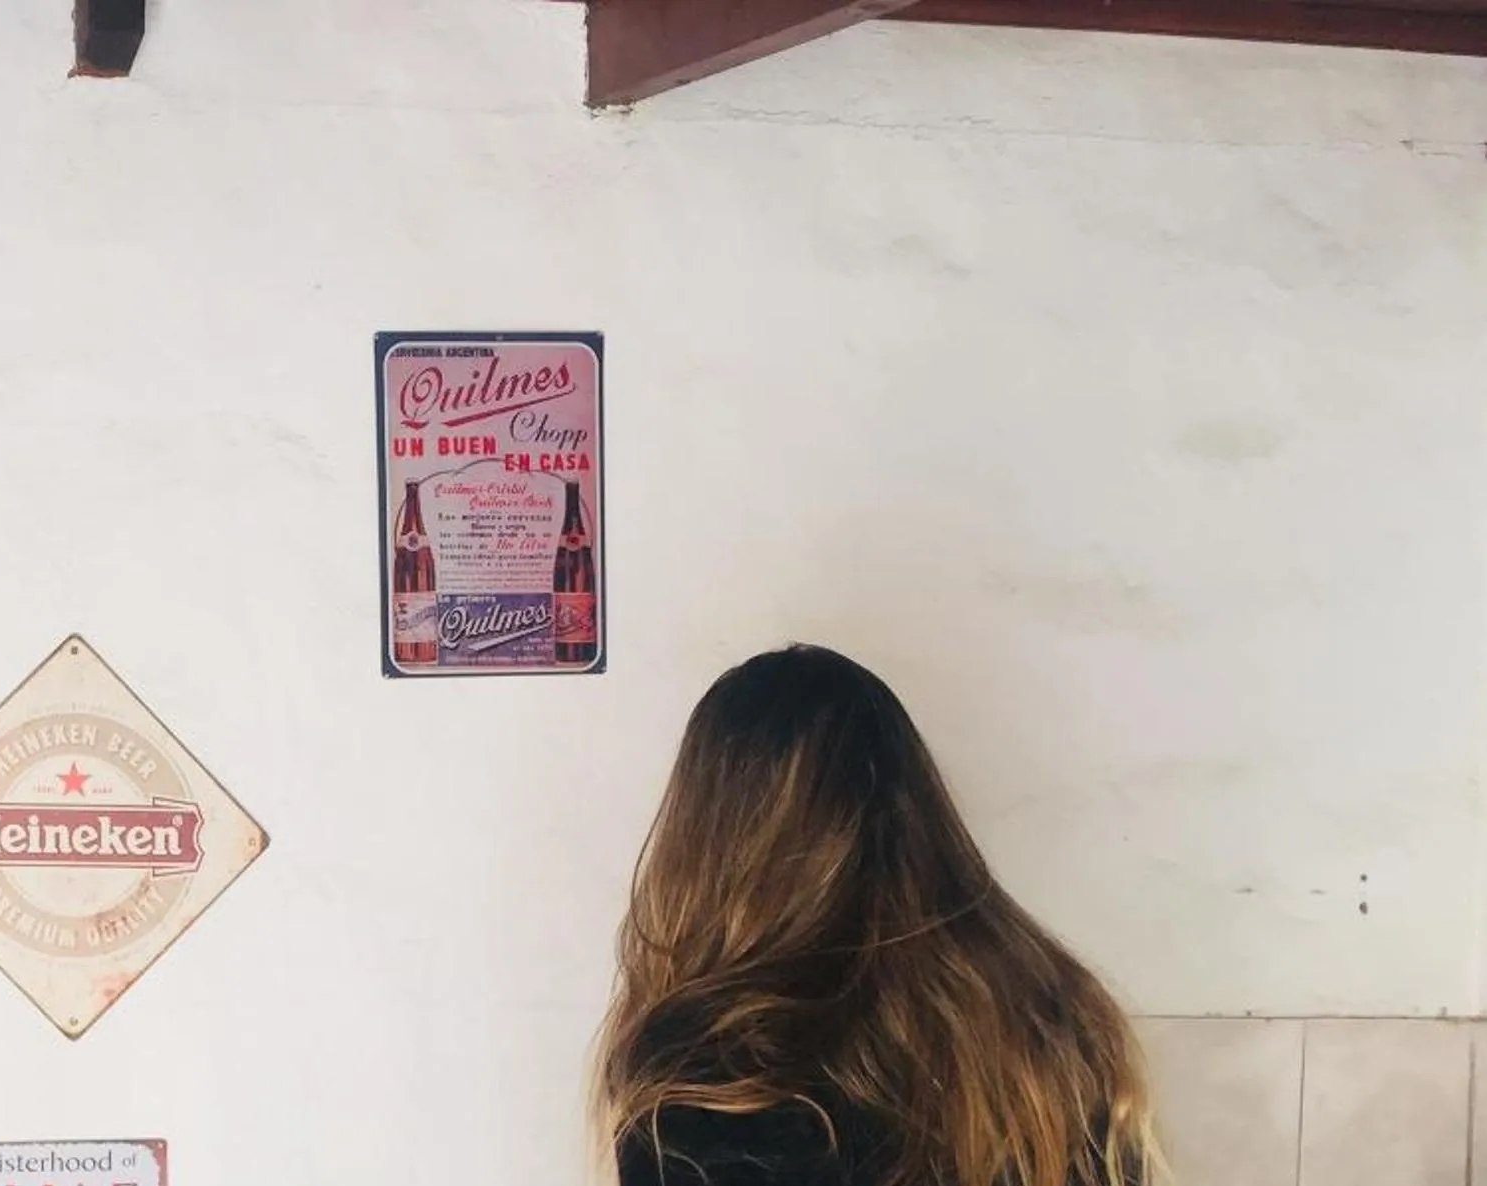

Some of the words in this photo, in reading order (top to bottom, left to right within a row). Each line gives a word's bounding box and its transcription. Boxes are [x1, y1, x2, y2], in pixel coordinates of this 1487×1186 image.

[399, 356, 575, 429] Quilmes
[393, 438, 424, 457] UN
[438, 436, 496, 455] BUEN
[510, 410, 588, 450] Chopp
[505, 453, 530, 472] EN
[540, 453, 591, 471] CASA
[439, 604, 554, 650] Quilmes
[107, 732, 158, 779] BEER
[86, 884, 164, 947] QUALITY
[122, 1153, 138, 1168] of
